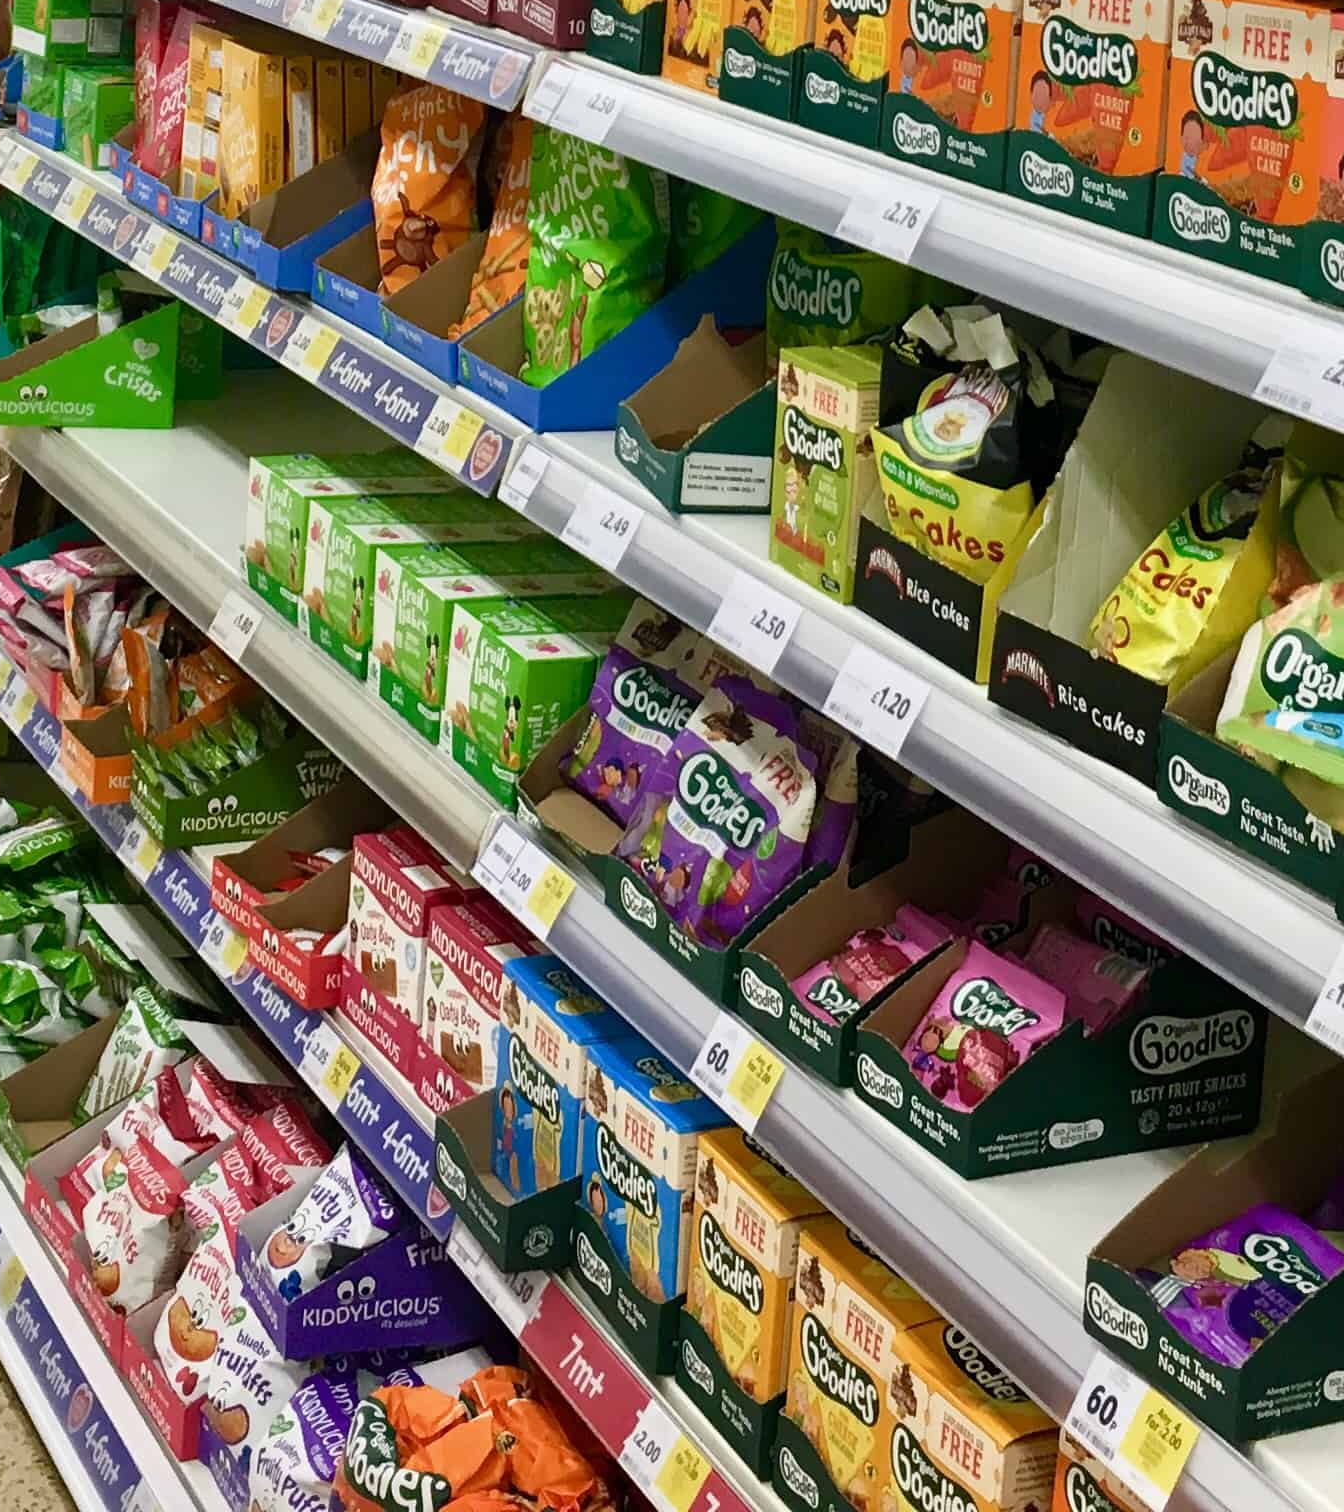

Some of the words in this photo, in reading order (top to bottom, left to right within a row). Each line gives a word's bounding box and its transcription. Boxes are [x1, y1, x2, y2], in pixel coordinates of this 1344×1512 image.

[567, 19, 585, 36] 10
[440, 43, 490, 79] 4-6m+
[1250, 135, 1290, 160] CARROT
[1256, 156, 1282, 177] CAKE
[103, 365, 162, 403] Crisps
[329, 357, 371, 395] 4-6m+
[374, 381, 419, 424] 4-6m+
[600, 512, 631, 537] £2.49
[906, 577, 930, 604] Rice
[931, 598, 970, 632] Cakes
[750, 608, 787, 641] £2.50
[870, 686, 911, 721] £1.20
[1006, 652, 1051, 690] MARMITE
[1058, 684, 1088, 714] Rice
[1091, 708, 1146, 745] Cakes
[180, 810, 289, 832] KIDDYLICIOUS
[353, 847, 422, 928] KIDDYLICIOUS
[360, 924, 377, 944] Oaty
[377, 931, 395, 952] Bars
[430, 919, 502, 1000] KIDDYLICIOU
[439, 1001, 456, 1024] Oaty
[458, 1009, 481, 1036] Bars
[1130, 1086, 1165, 1105] TASTY
[1168, 1080, 1201, 1100] FRUIT
[1203, 1073, 1247, 1094] SNACKS
[381, 1124, 430, 1183] 4-6m+
[301, 1296, 441, 1329] KIDDYLICIOUS
[558, 1334, 605, 1396] 7m+
[1087, 1385, 1117, 1431] 60p
